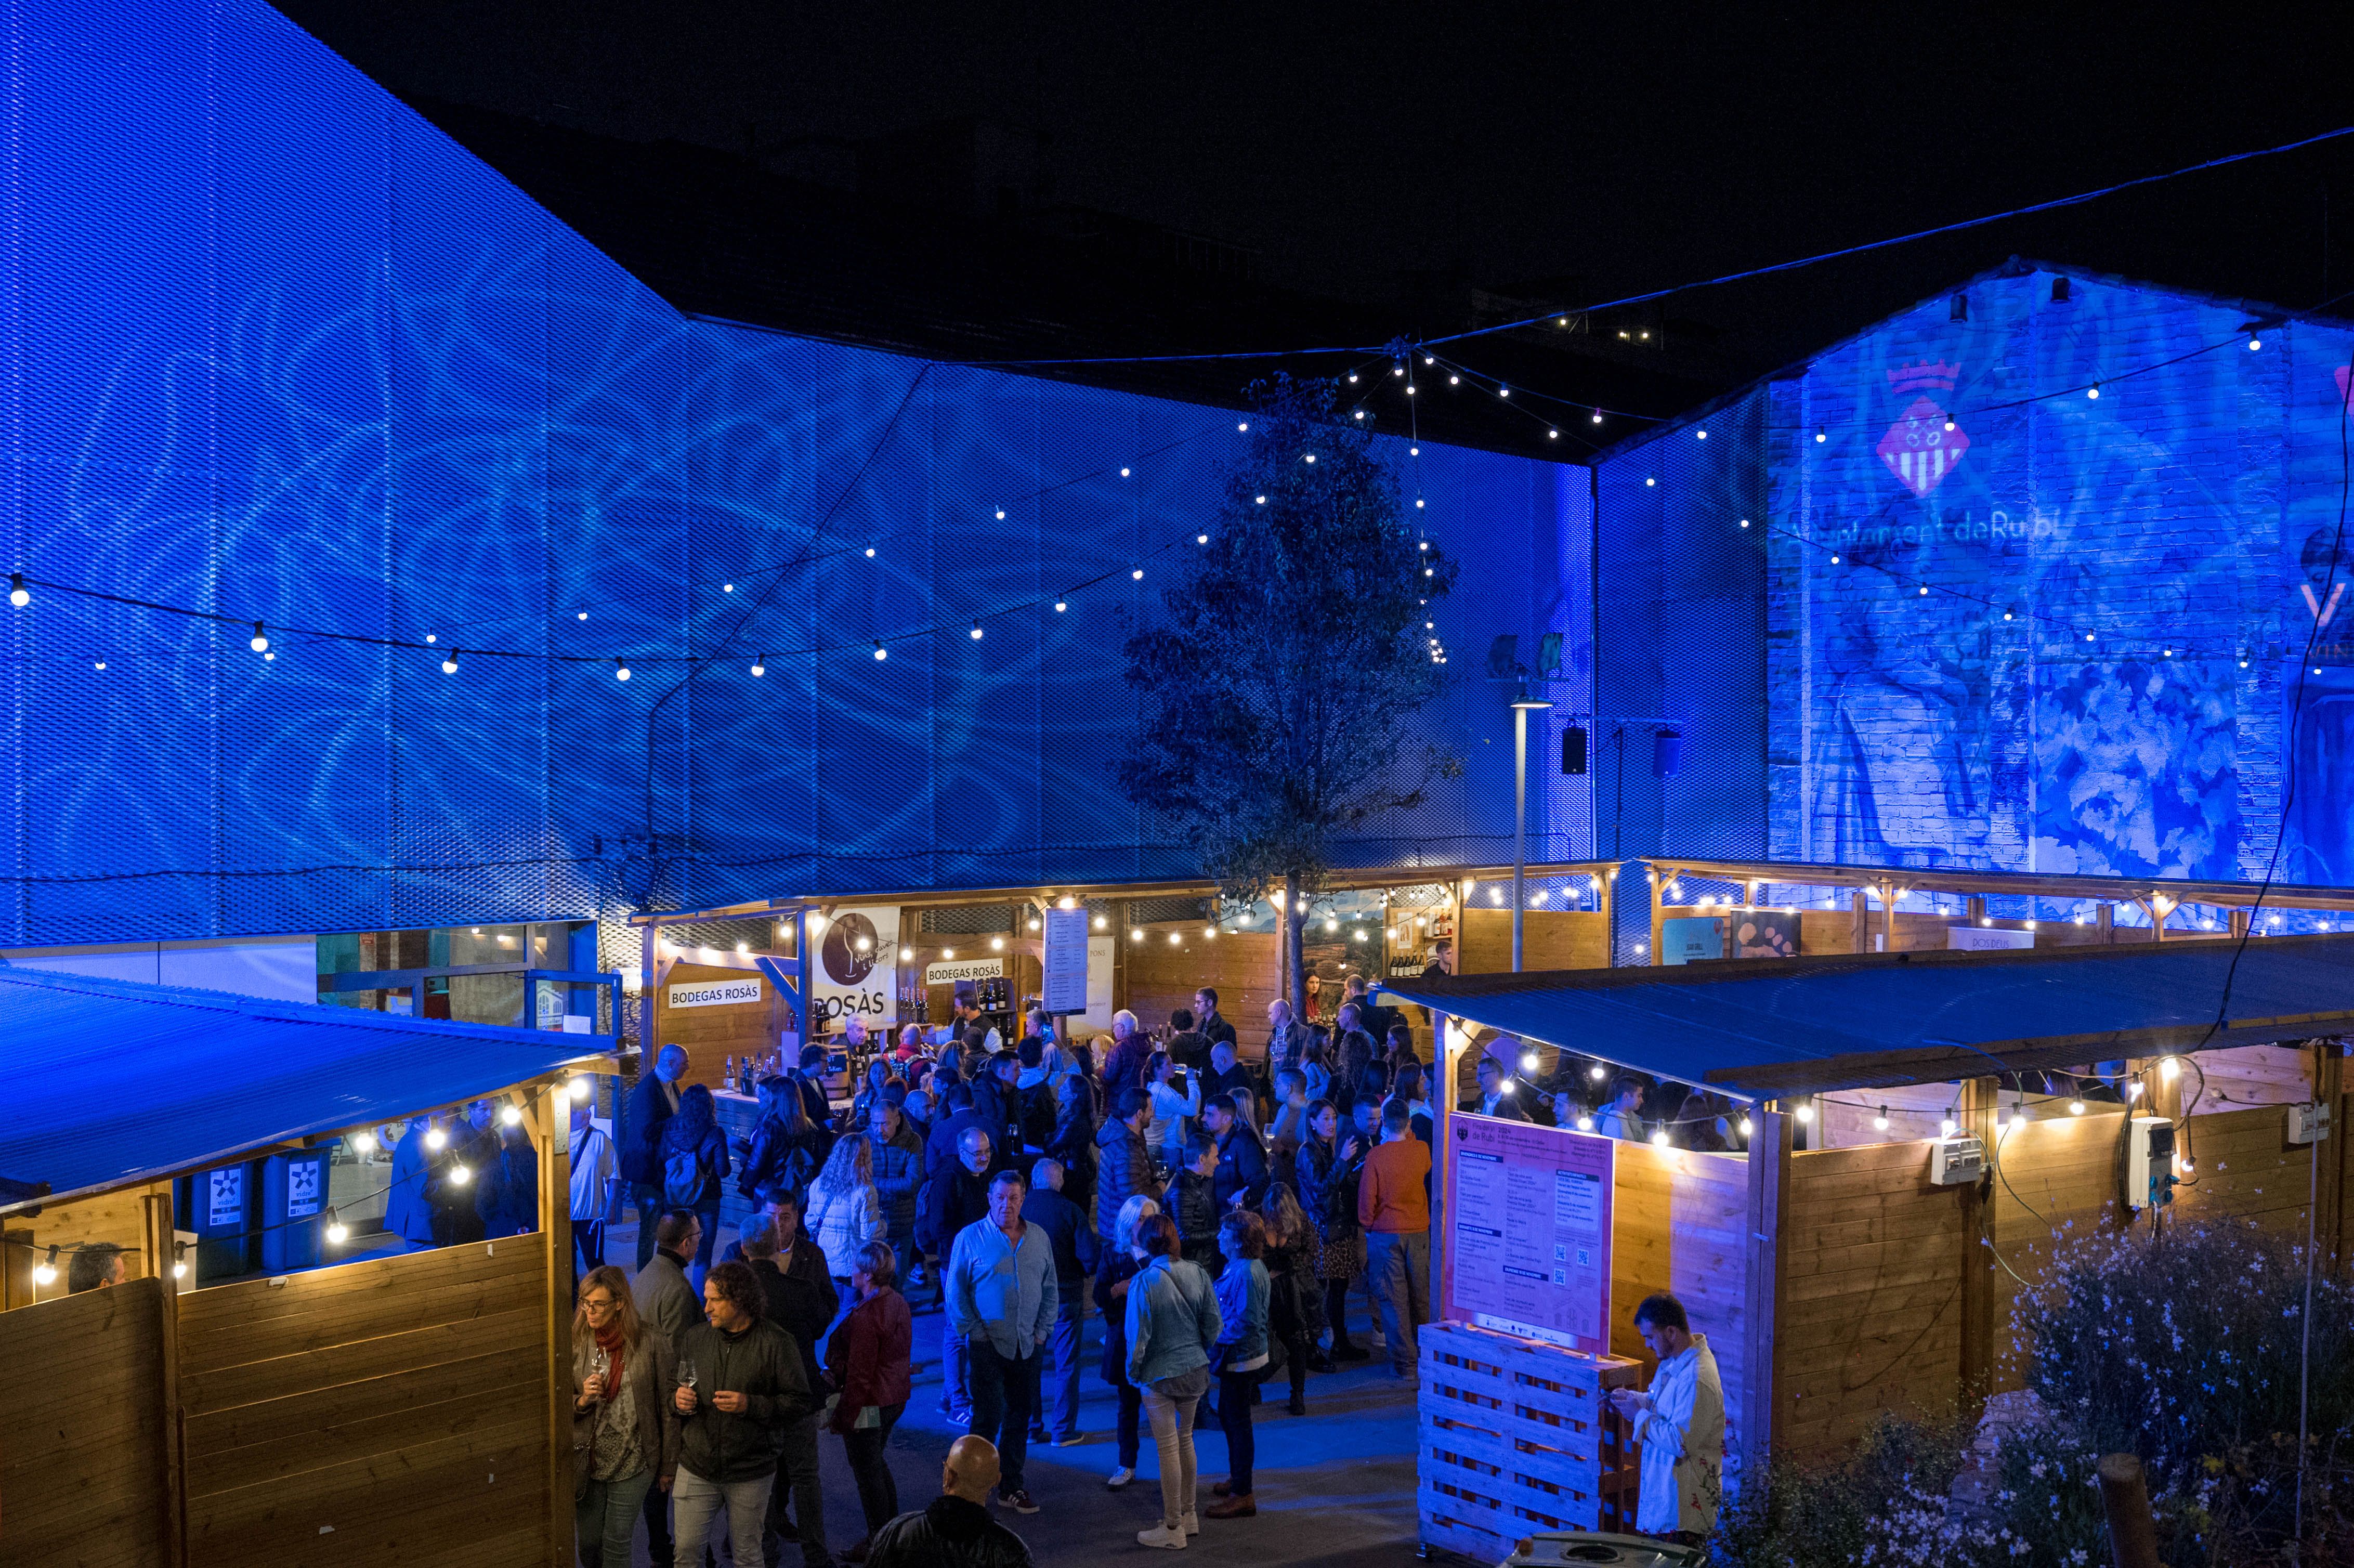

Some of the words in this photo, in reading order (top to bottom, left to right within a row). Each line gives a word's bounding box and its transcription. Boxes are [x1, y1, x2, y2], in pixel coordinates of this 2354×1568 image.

[1973, 938, 1990, 948] DOS
[869, 952, 889, 967] licors
[930, 968, 970, 980] BODEGAS
[973, 964, 1000, 976] ROSÀS
[672, 990, 722, 1003] BODEGAS
[726, 985, 757, 999] ROSÀS
